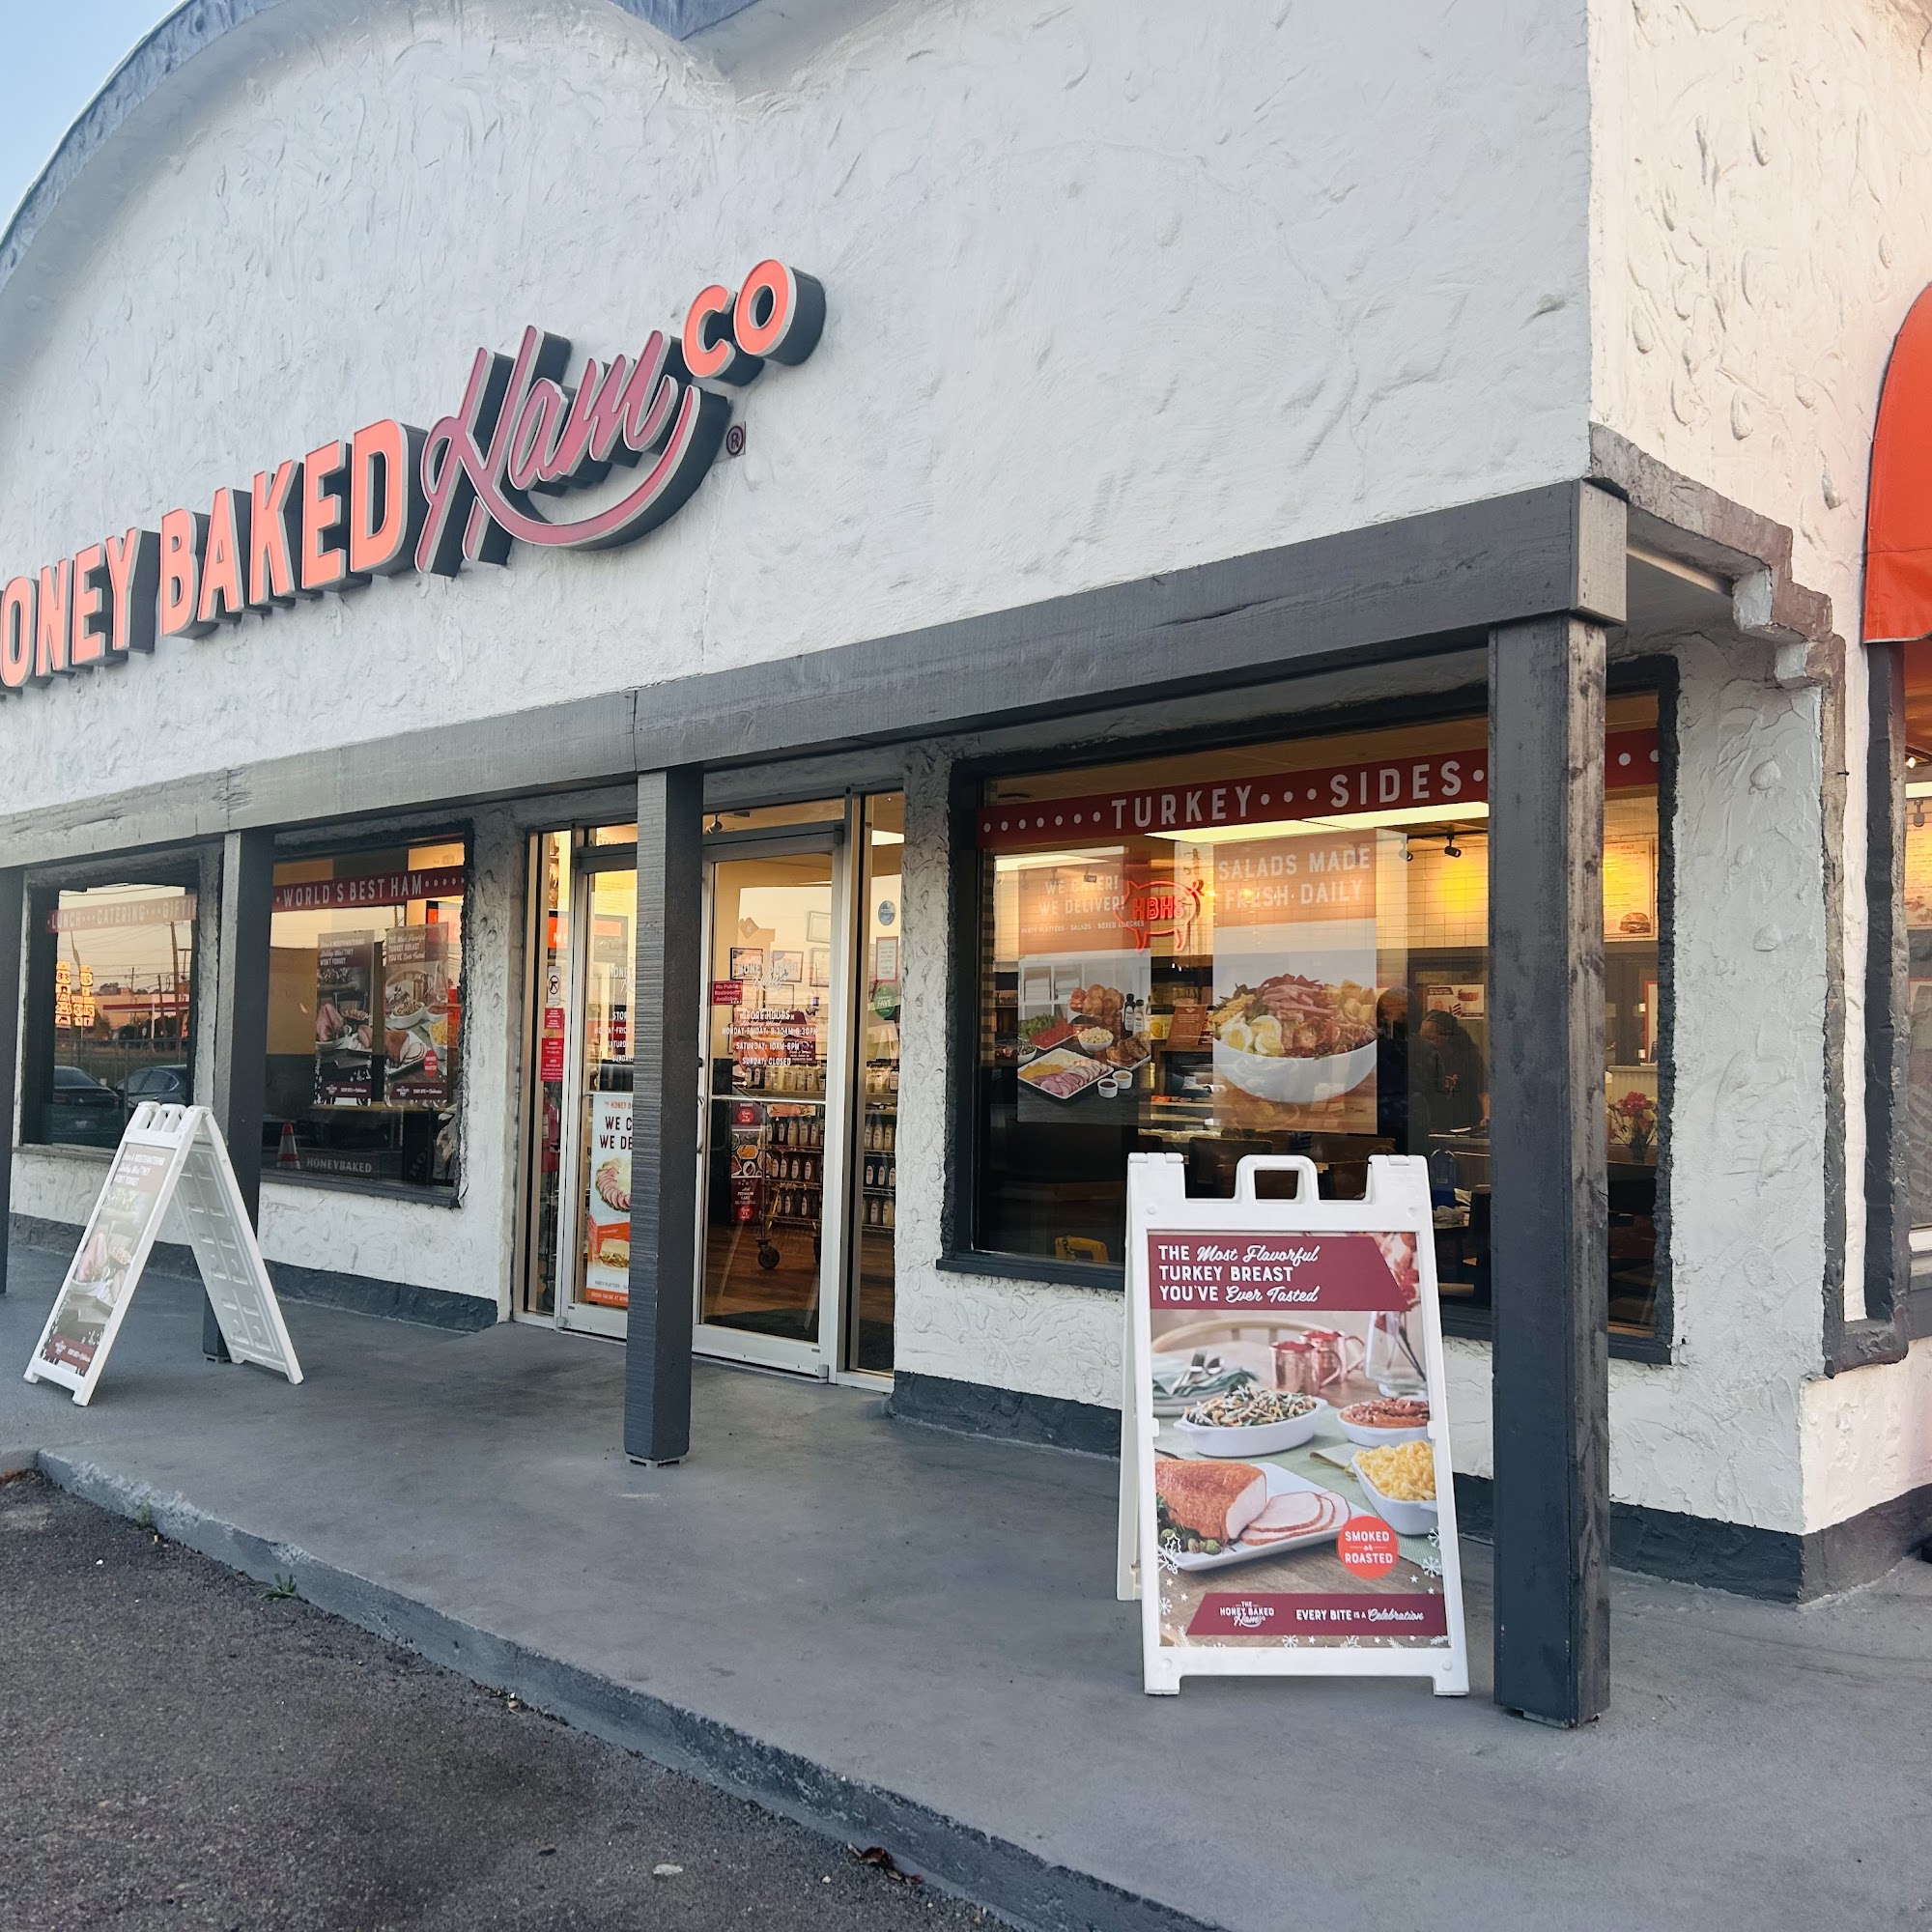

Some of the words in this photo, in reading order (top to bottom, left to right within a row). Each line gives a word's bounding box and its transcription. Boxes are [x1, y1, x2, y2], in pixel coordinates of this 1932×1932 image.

[0, 527, 153, 690] ONEY
[159, 418, 421, 638] BAKED
[415, 325, 723, 576] Ham
[682, 258, 817, 380] CO
[1111, 784, 1253, 829] TURKEY
[1330, 760, 1462, 809] SIDES
[1218, 854, 1297, 881] SALADS
[1309, 847, 1371, 873] MADE
[283, 880, 344, 908] WORLD'S
[350, 878, 385, 901] BEST
[390, 874, 422, 897] HAM
[1045, 881, 1065, 895] WE
[1226, 885, 1289, 910] FRESH
[1300, 879, 1363, 905] DAILY
[1038, 901, 1059, 917] WE
[1065, 895, 1125, 915] DELIVER!
[51, 911, 81, 929] LUNCH
[98, 903, 145, 924] CATERING
[768, 1057, 792, 1065] CLOSED
[605, 1116, 620, 1130] WE
[599, 1134, 614, 1150] WE
[306, 1157, 373, 1174] HONEYBAKED
[1157, 1244, 1190, 1261] THE
[1196, 1244, 1238, 1262] Most
[1242, 1244, 1321, 1267] Flavorful
[1158, 1265, 1223, 1281] TURKEY
[1230, 1265, 1293, 1282] BREAST
[1158, 1285, 1219, 1302] YOU'VE
[1225, 1285, 1264, 1304] Ever
[1266, 1285, 1321, 1303] Tasted
[1344, 1530, 1390, 1543] SMOKED
[1344, 1552, 1393, 1564] ROASTED
[1219, 1606, 1247, 1616] HONEY
[1248, 1606, 1274, 1616] BAKED
[1295, 1608, 1327, 1621] EVERY
[1329, 1609, 1352, 1621] BITE
[1367, 1607, 1425, 1622] Celebration
